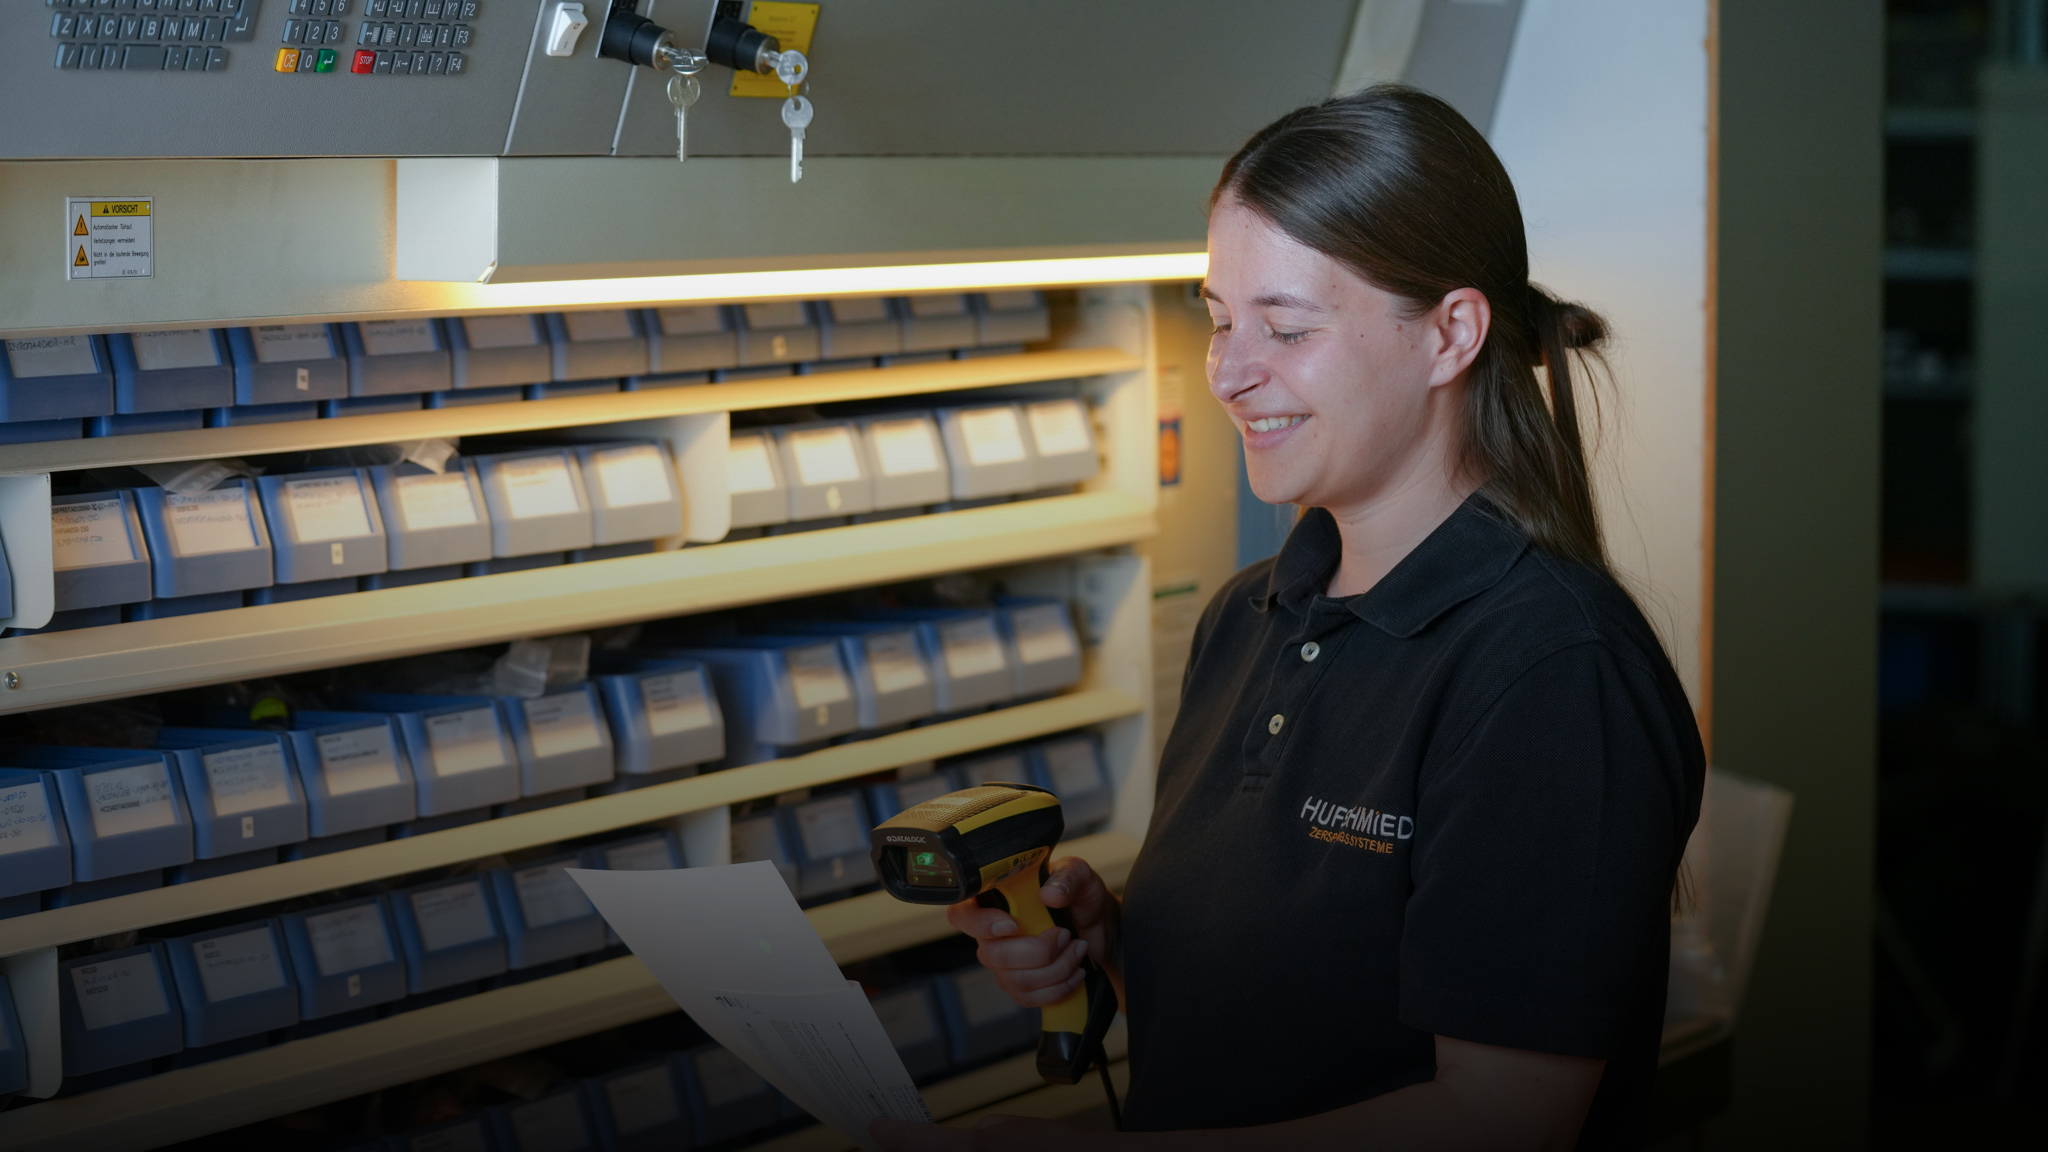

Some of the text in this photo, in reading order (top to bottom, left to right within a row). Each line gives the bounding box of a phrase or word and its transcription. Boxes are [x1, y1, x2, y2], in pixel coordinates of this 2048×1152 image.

[319, 0, 325, 10] 5
[338, 0, 345, 11] 6
[464, 3, 476, 16] F2
[61, 18, 71, 34] Z
[83, 19, 92, 34] X
[105, 19, 115, 35] C
[127, 20, 136, 35] V
[147, 21, 156, 36] B
[168, 22, 178, 36] N
[188, 22, 199, 37] M
[294, 25, 339, 40] 1 2 3
[457, 31, 469, 43] F3
[284, 53, 312, 68] CE 0
[359, 55, 374, 65] STOP
[436, 57, 442, 69] ?
[451, 58, 462, 70] F4
[112, 204, 138, 214] VORSICHT
[132, 250, 149, 258] Bewegung
